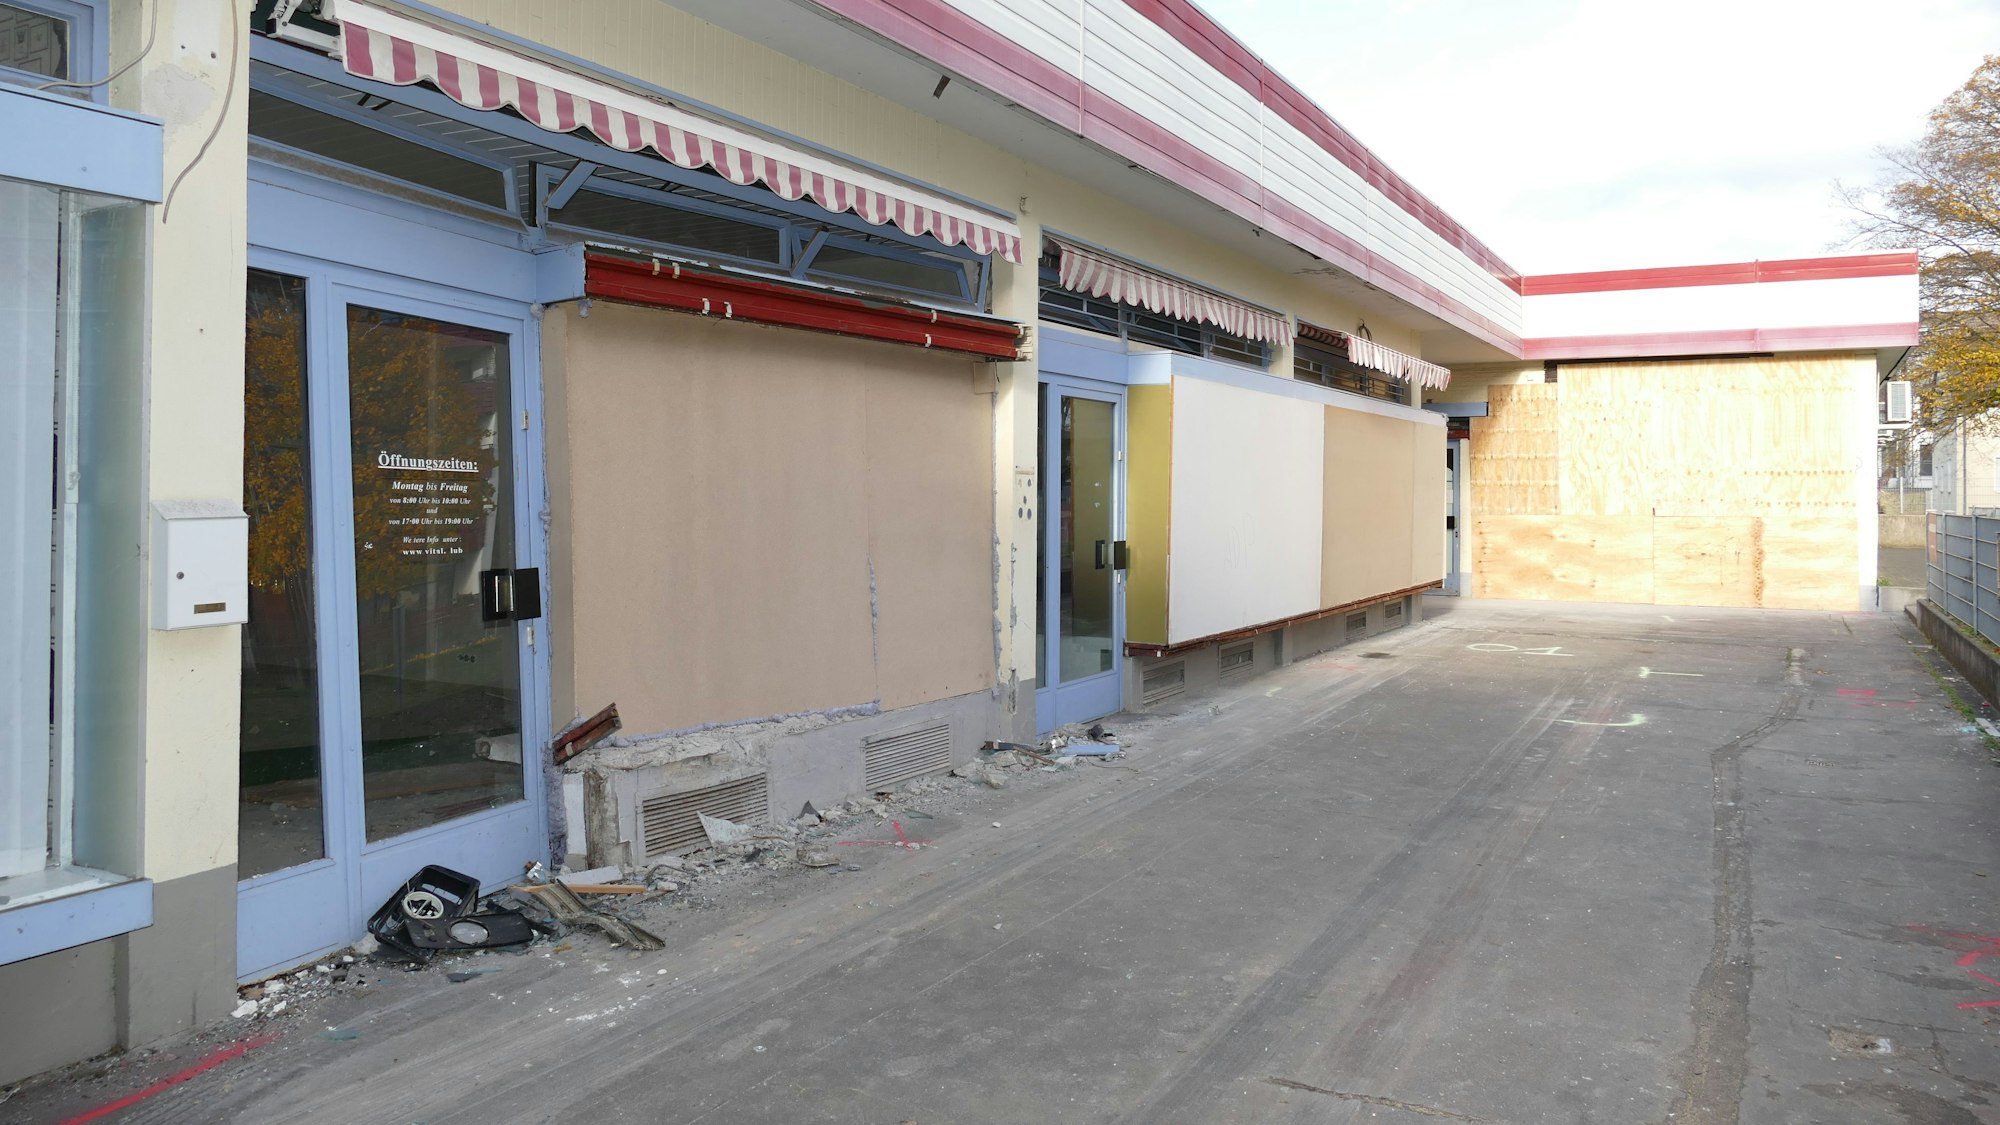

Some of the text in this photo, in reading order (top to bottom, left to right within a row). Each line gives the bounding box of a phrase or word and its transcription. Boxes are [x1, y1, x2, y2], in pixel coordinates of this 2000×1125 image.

[378, 450, 478, 471] Öffnungszeiten:
[392, 481, 468, 493] Montag bis Freitag
[444, 517, 461, 525] 19:00
[427, 536, 439, 544] Info
